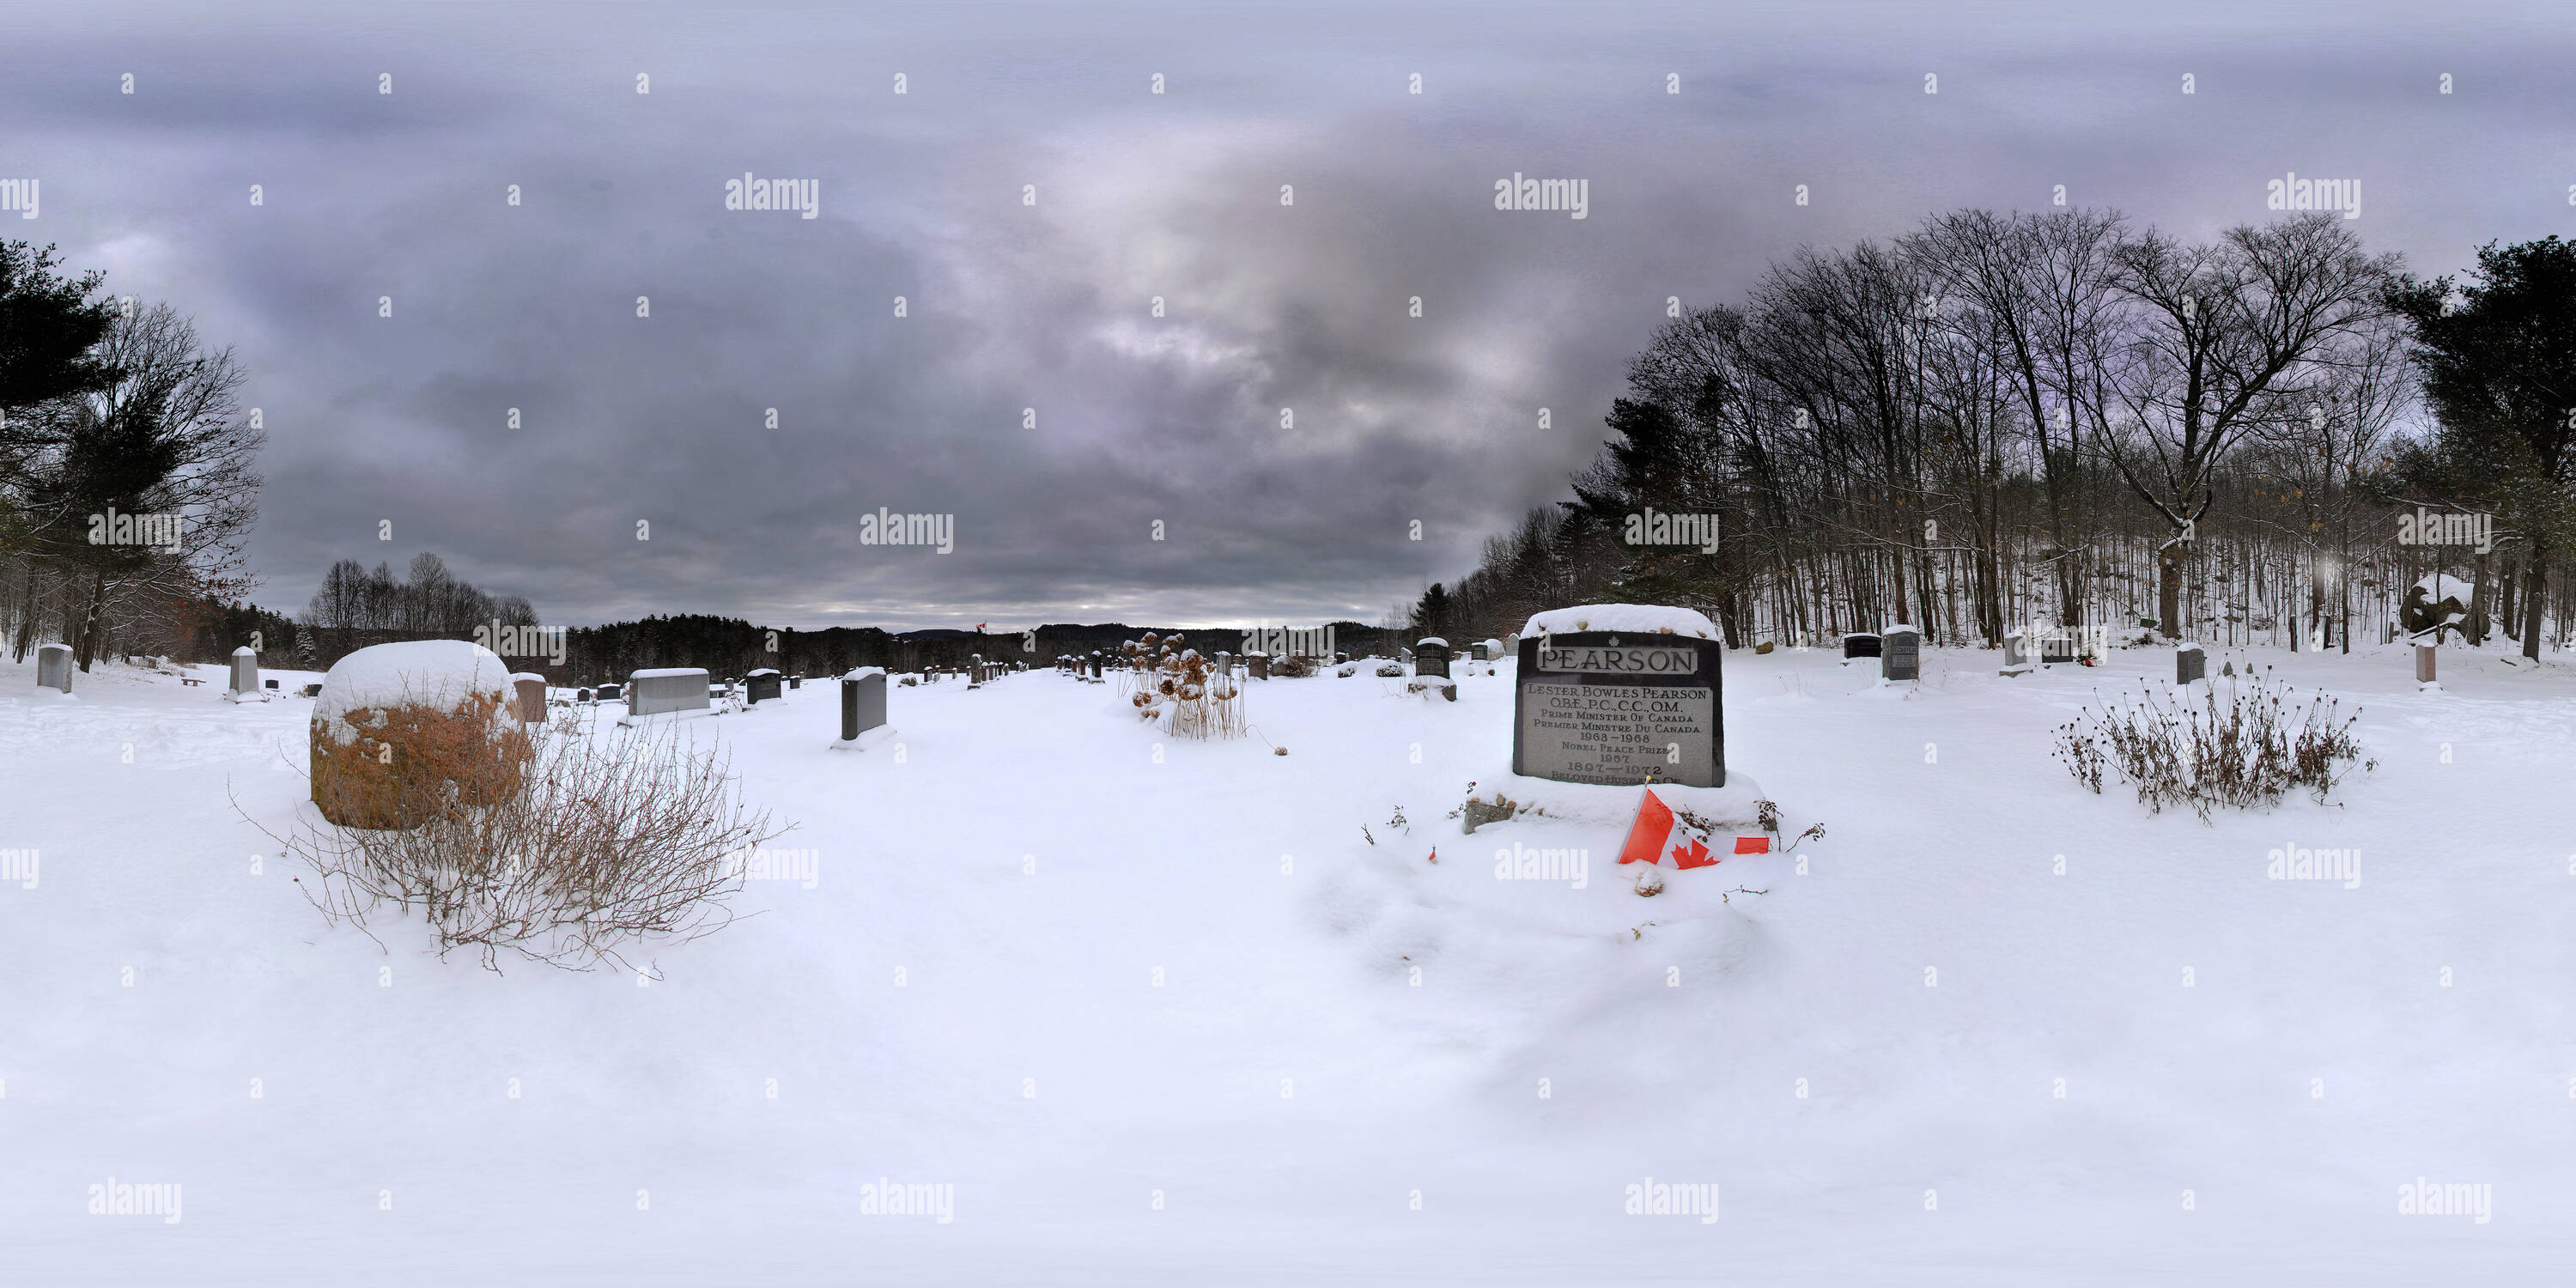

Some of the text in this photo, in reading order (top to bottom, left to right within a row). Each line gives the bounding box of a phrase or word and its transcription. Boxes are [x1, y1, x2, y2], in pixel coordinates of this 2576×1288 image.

[1540, 649, 1694, 671] PEARSON
[1528, 683, 1707, 700] LESTER BOWLES PEARSON
[1540, 708, 1573, 719] PRIME
[1576, 711, 1627, 721] MINISTER
[1649, 713, 1693, 722] CANADA
[1534, 719, 1579, 730] PREMIER
[1582, 722, 1631, 732] MINISTRE
[1655, 724, 1701, 733] CANADA
[1562, 741, 1596, 752] NOBEL
[1600, 744, 1635, 754] PEACE
